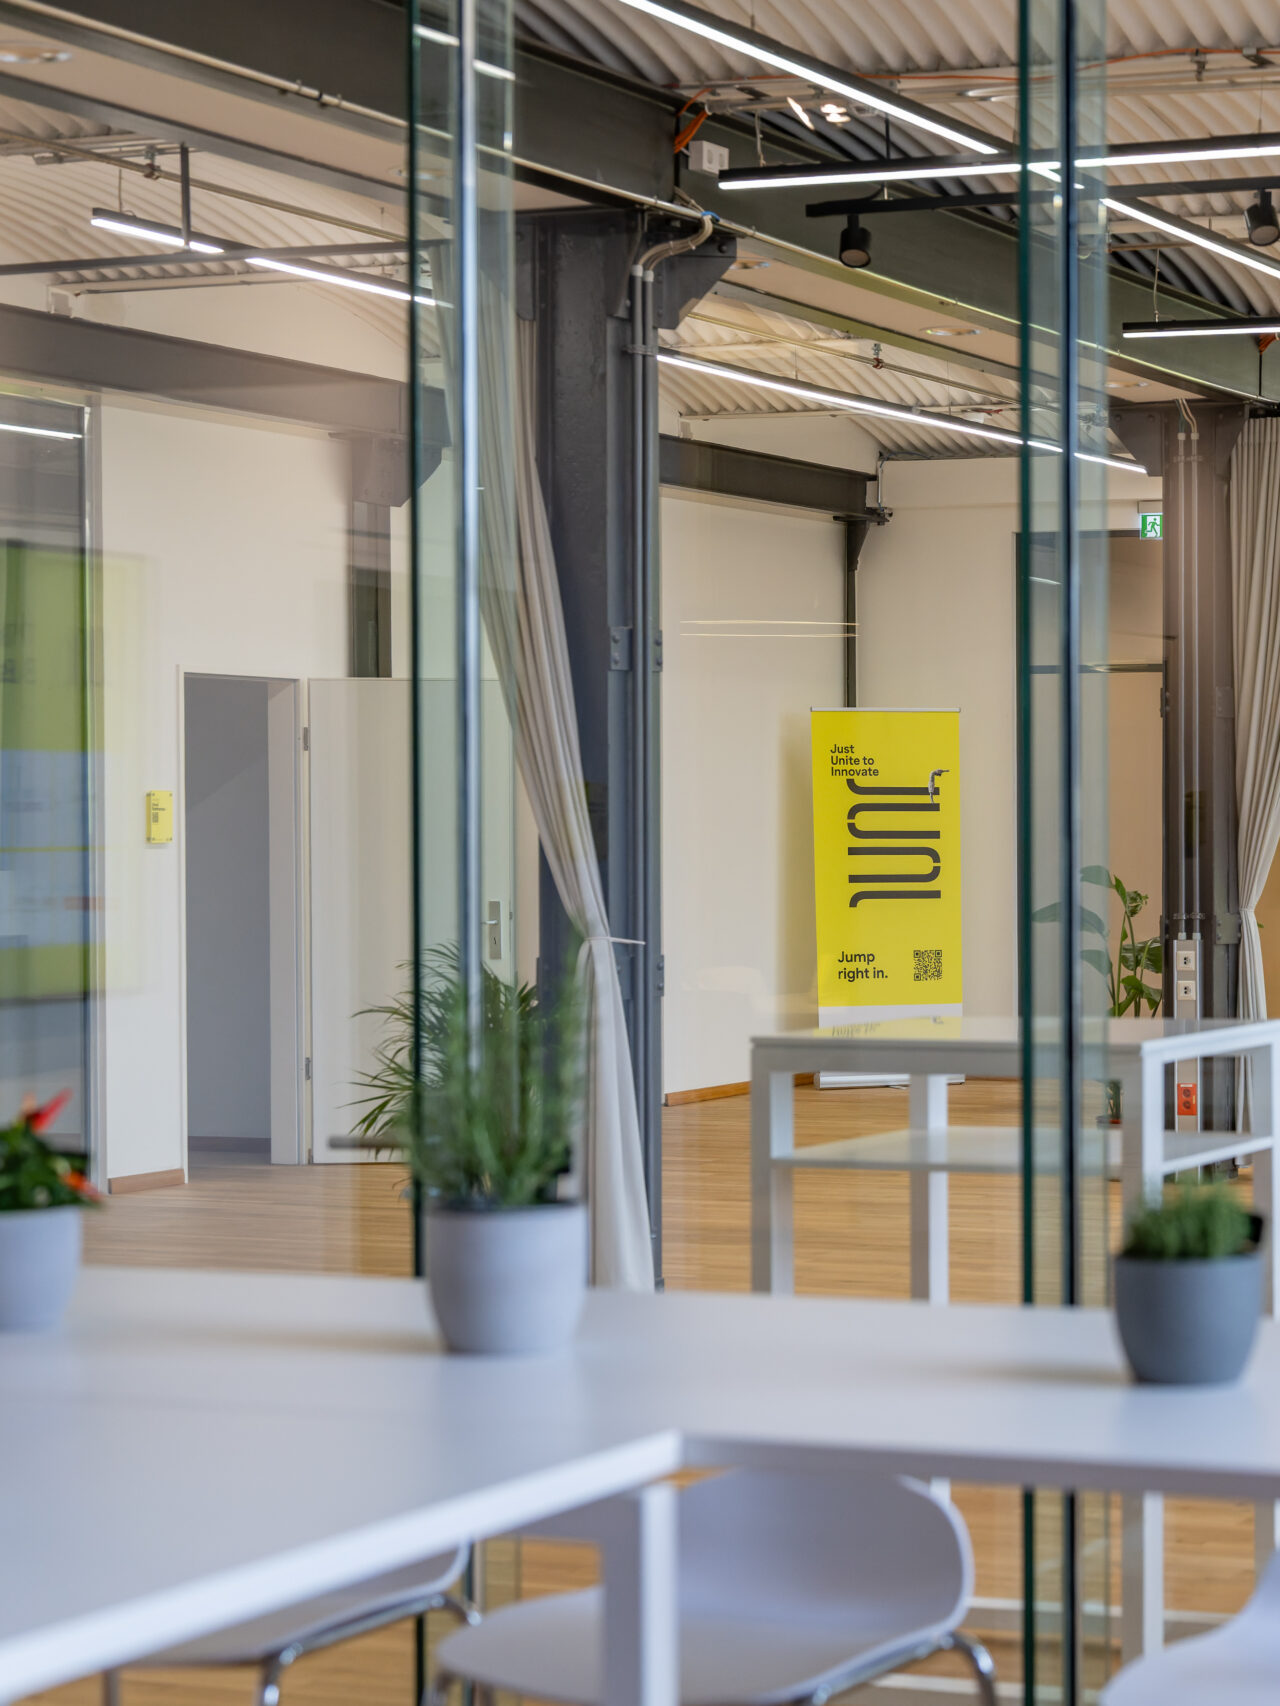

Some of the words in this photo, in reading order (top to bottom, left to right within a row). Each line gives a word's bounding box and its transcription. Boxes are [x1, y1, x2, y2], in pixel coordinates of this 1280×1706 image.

[830, 744, 855, 754] Just
[831, 755, 860, 766] Unite
[863, 756, 875, 766] to
[831, 767, 879, 777] Innovate
[838, 951, 876, 965] Jump
[838, 967, 870, 982] right
[873, 967, 888, 979] in.
